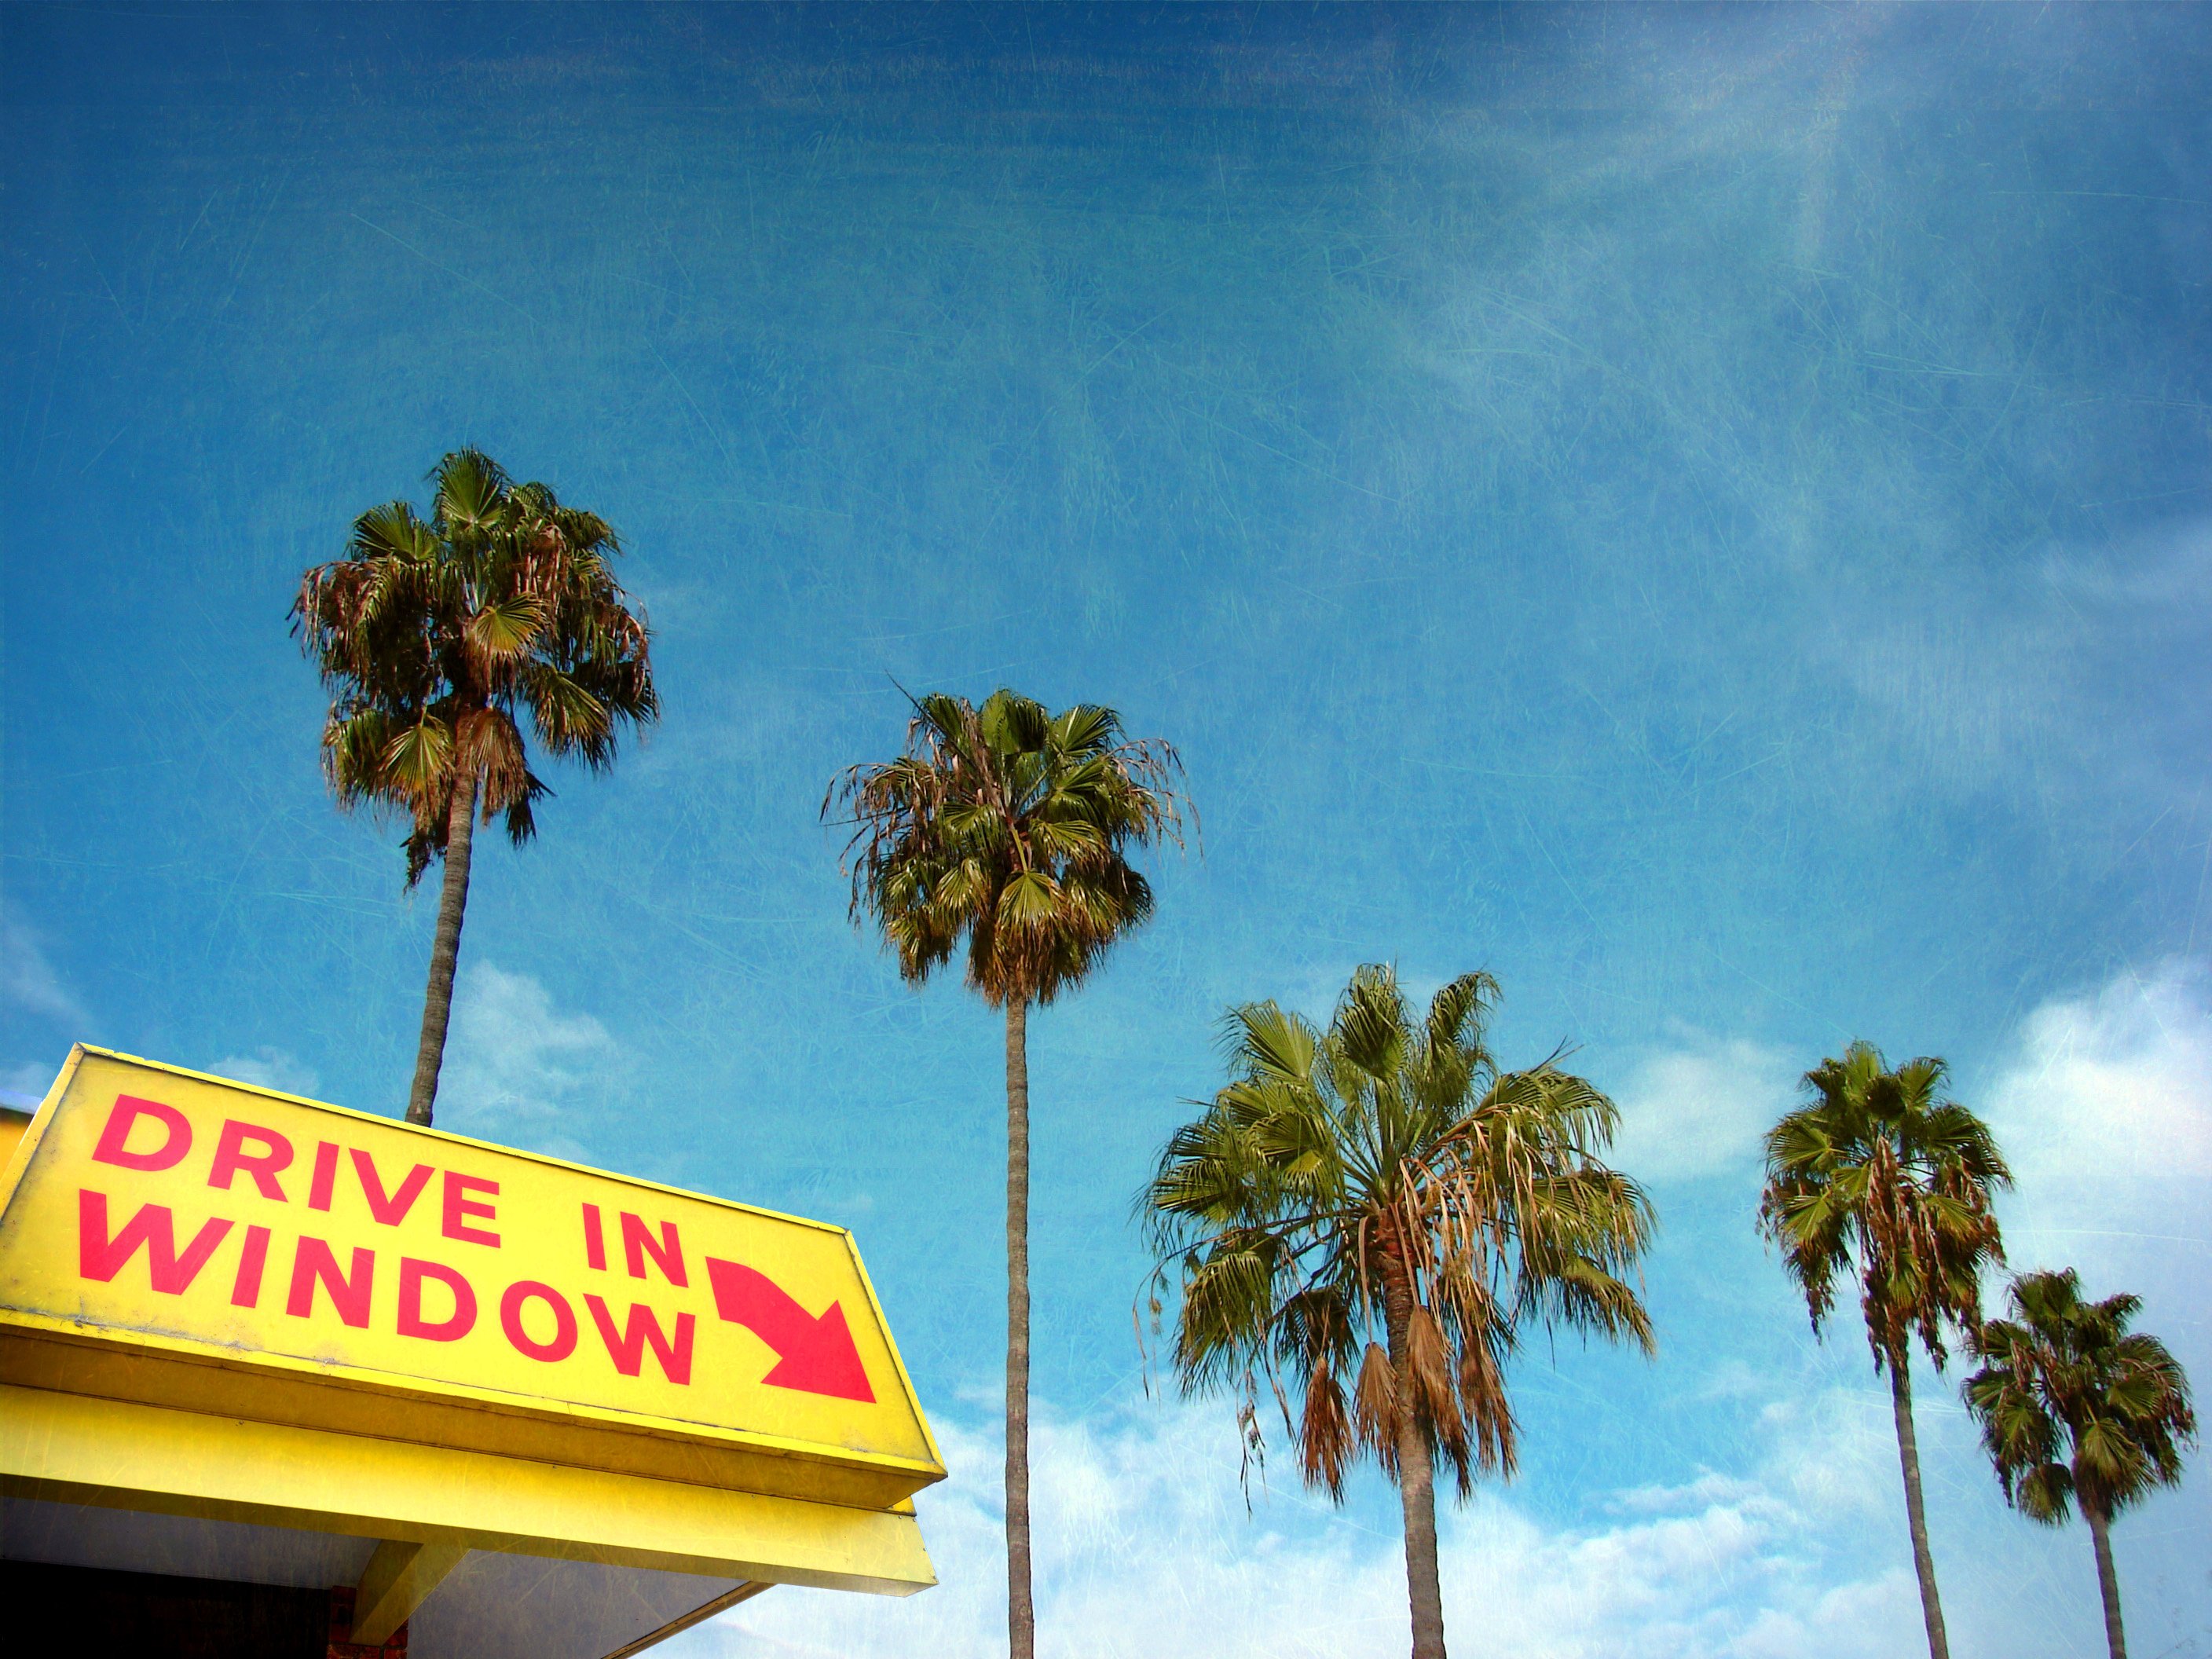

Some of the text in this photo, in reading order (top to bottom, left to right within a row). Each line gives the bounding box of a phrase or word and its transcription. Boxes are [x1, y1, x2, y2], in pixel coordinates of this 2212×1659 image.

[79, 1188, 696, 1386] WINDOW
[92, 1093, 689, 1288] DRIVE IN
